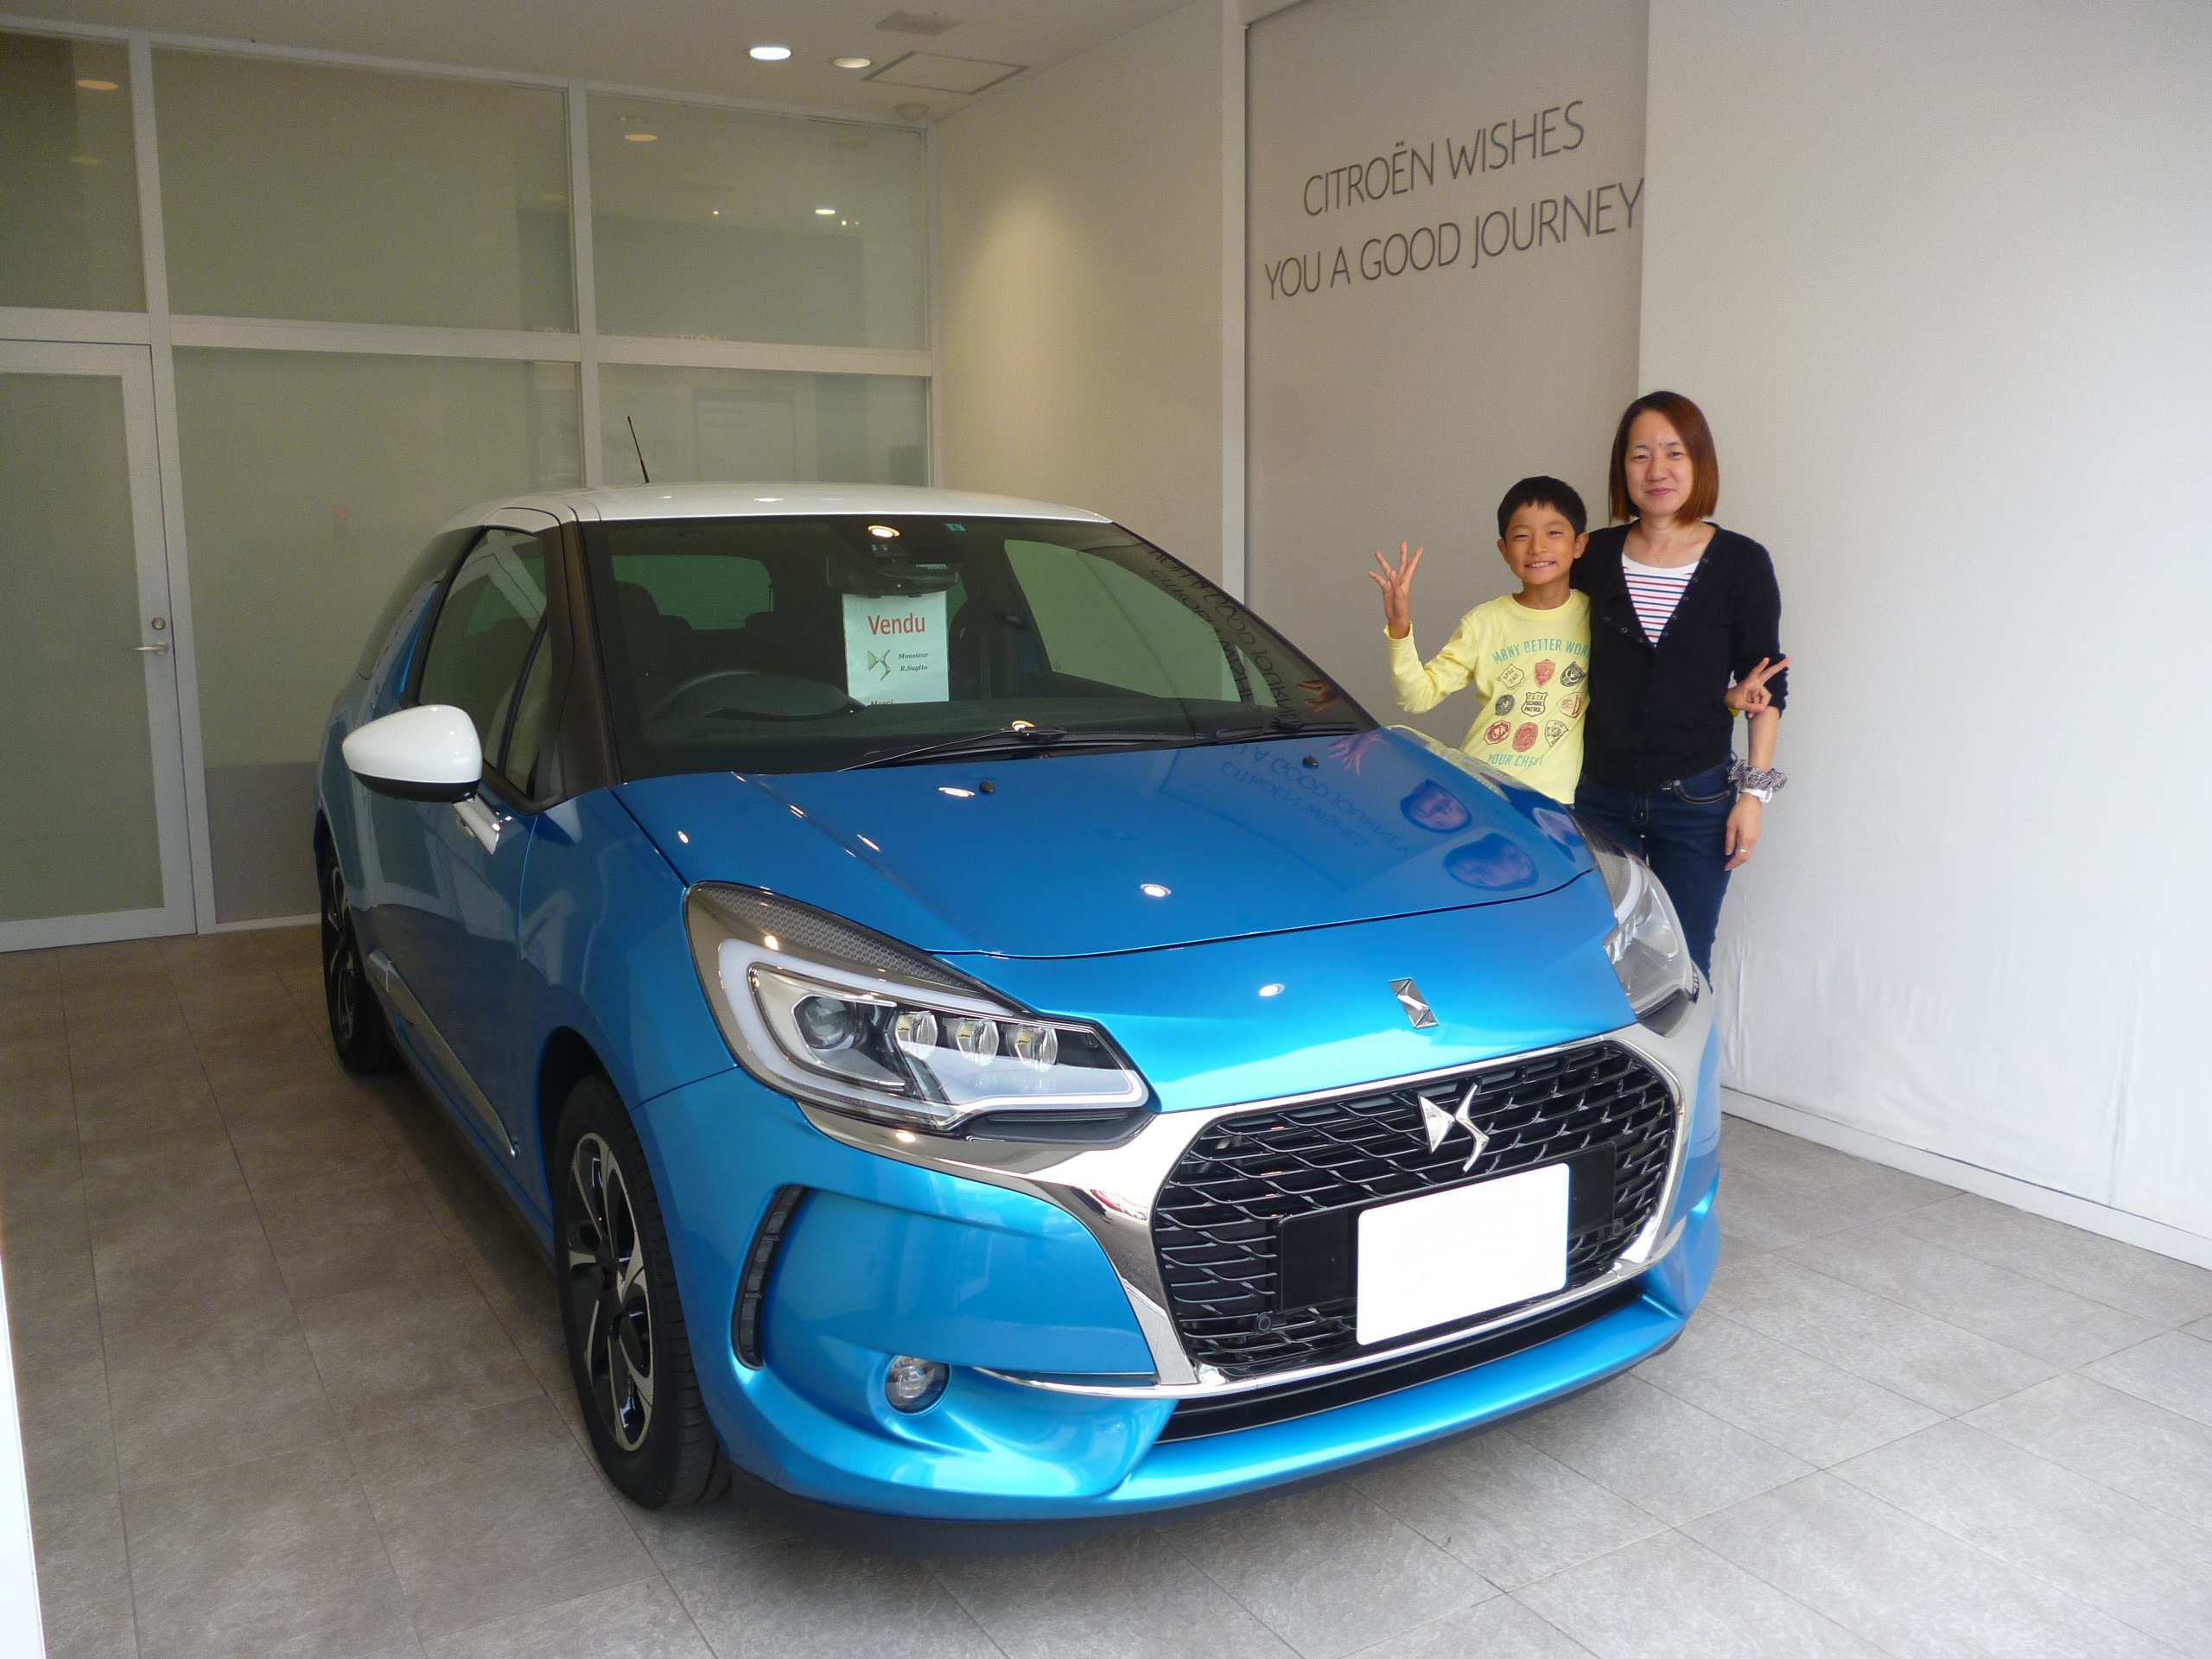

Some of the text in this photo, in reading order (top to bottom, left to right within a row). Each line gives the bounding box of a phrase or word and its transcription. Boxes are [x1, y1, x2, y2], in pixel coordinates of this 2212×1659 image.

[1303, 100, 1586, 216] CITROËN WISHES
[1264, 177, 1645, 301] YOU A GOOD JOURNEY
[867, 612, 925, 636] Vendu
[898, 652, 930, 660] Monsieur
[1492, 644, 1520, 664] MANY
[1523, 638, 1562, 654] BETTER
[1487, 753, 1514, 766] YOUR
